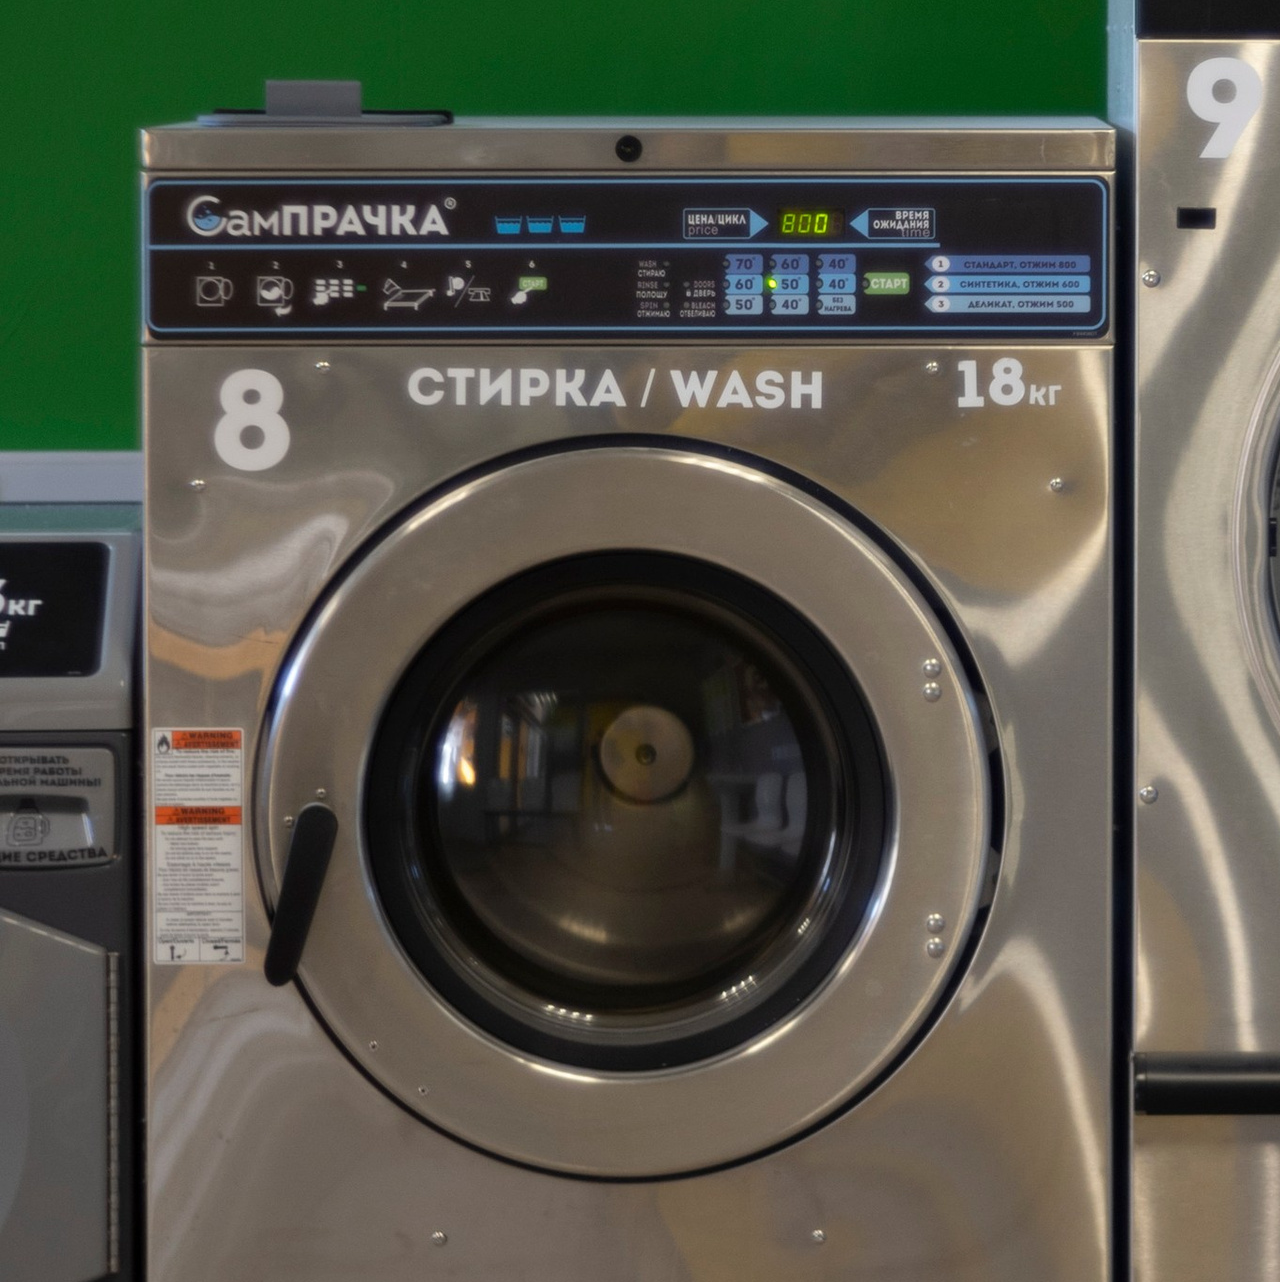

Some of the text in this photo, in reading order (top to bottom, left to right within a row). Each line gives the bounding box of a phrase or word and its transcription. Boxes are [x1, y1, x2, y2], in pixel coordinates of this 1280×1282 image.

[1186, 57, 1262, 158] 9
[688, 214, 747, 226] ЦЕНА/ЦИКЛ
[895, 211, 930, 220] ВРЕМЯ
[782, 213, 829, 234] 800
[873, 220, 930, 230] ОЖИДАНИЯ
[688, 225, 719, 237] price
[901, 227, 931, 238] time
[638, 260, 657, 268] WASH
[938, 260, 1077, 270] 1 СТАНДАРТ, ОТЖИМ 800
[638, 270, 666, 278] СТИРАЮ
[637, 281, 659, 289] RINSE
[871, 278, 908, 290] СТАРТ
[938, 280, 1080, 290] 2 СИНТЕТИКА, ОТЖИМ 600
[693, 290, 716, 298] ДВЕРЬ
[938, 300, 944, 308] 3
[968, 301, 1015, 310] ДЕЛИКАТ,
[407, 367, 626, 407] СТИРКА
[670, 370, 823, 409] WASH
[214, 369, 290, 471] 8
[34, 767, 82, 775] РАБОТЫ
[181, 807, 225, 815] WARNING
[27, 847, 108, 862] СРЕДСТВА
